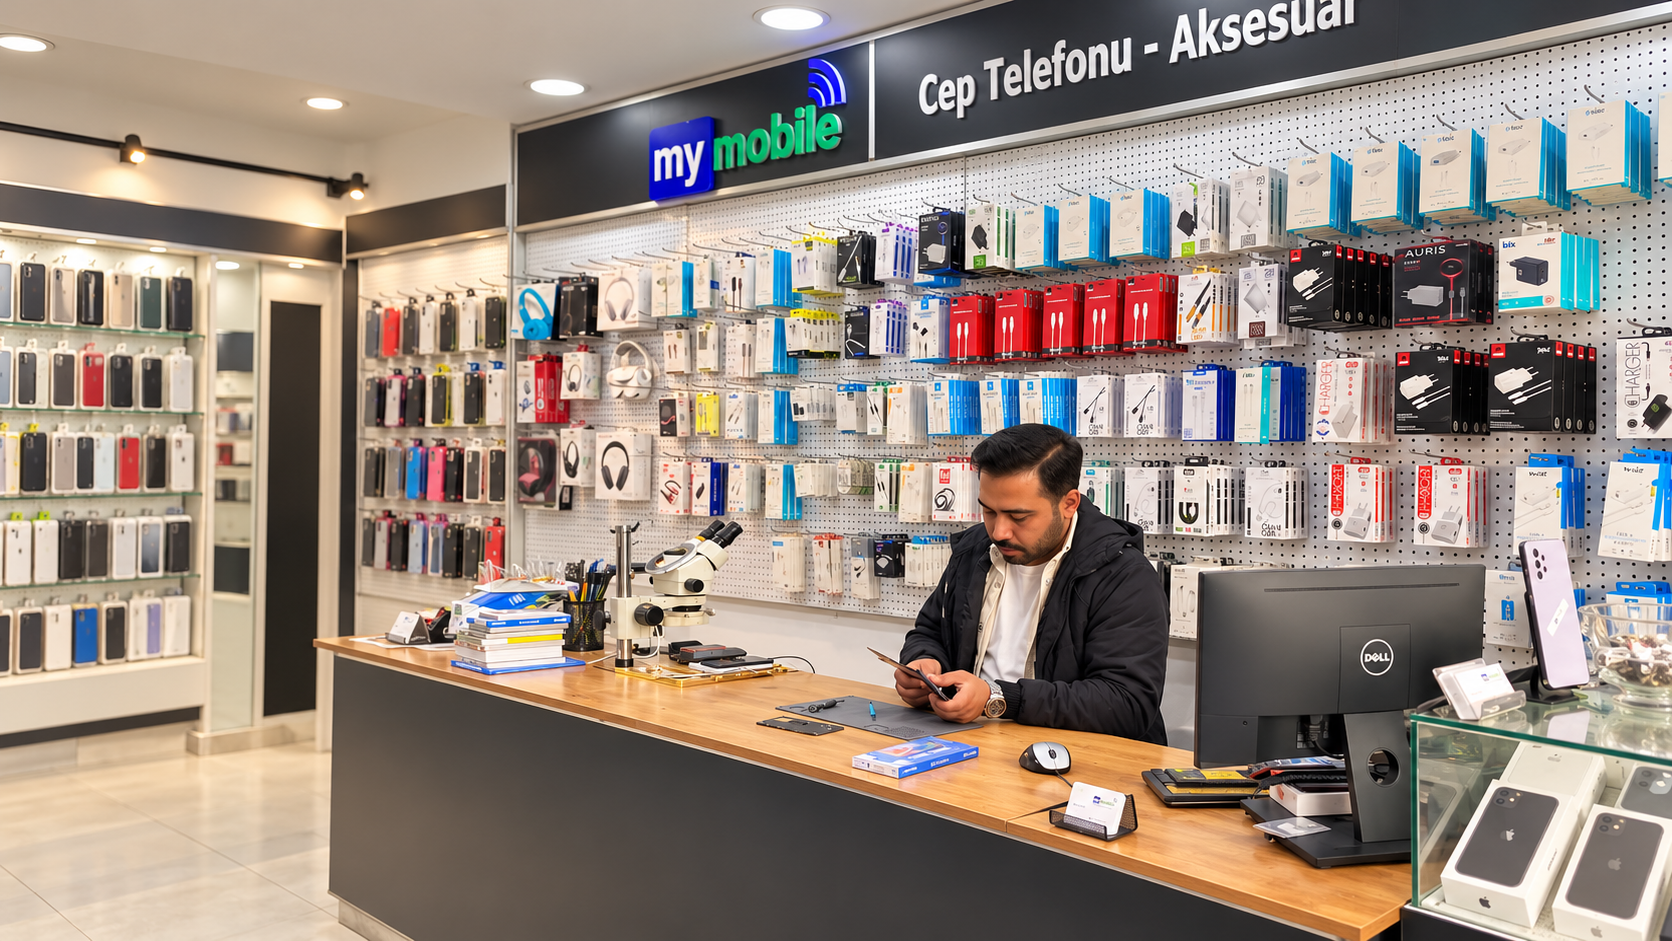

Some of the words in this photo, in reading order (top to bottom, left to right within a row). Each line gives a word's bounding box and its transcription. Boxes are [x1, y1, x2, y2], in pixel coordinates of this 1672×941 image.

[918, 73, 976, 119] Cep
[983, 37, 1132, 101] Telefonu
[1144, 41, 1159, 55] -
[654, 140, 705, 187] my
[713, 104, 842, 171] mobile
[1404, 245, 1446, 258] AURIS
[1502, 241, 1516, 249] bix
[1624, 342, 1641, 408] CHARGER
[1364, 652, 1390, 662] DELL
